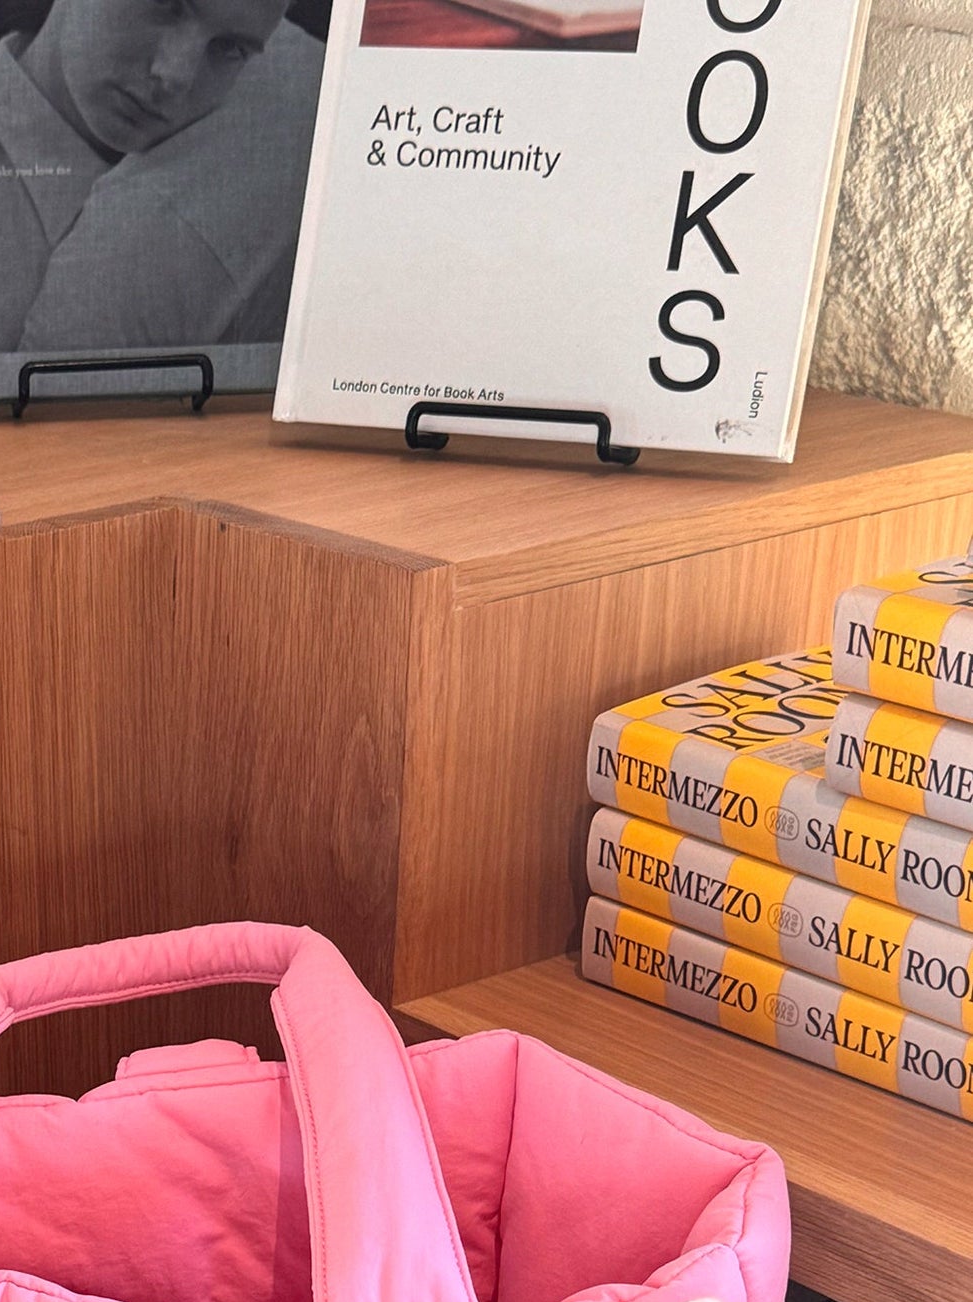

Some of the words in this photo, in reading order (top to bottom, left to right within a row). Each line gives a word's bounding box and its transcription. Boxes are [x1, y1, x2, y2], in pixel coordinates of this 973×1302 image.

[370, 104, 423, 136] Art,
[432, 106, 505, 136] Craft
[367, 141, 387, 167] &
[396, 142, 561, 178] Community
[332, 378, 377, 394] London
[380, 382, 421, 397] Centre
[423, 384, 441, 398] for
[443, 386, 475, 400] Book
[477, 388, 505, 402] Arts
[748, 371, 768, 419] Ludion
[661, 651, 832, 719] SALL
[596, 745, 758, 828] INTERMEZZO
[805, 818, 895, 875] SALLY
[597, 838, 762, 923] INTERMEZZO
[808, 916, 900, 973] SALLY
[904, 949, 973, 1002] ROO
[592, 927, 758, 1013] INTERMEZZO
[805, 1006, 896, 1064] SALLY
[902, 1040, 973, 1094] ROO
